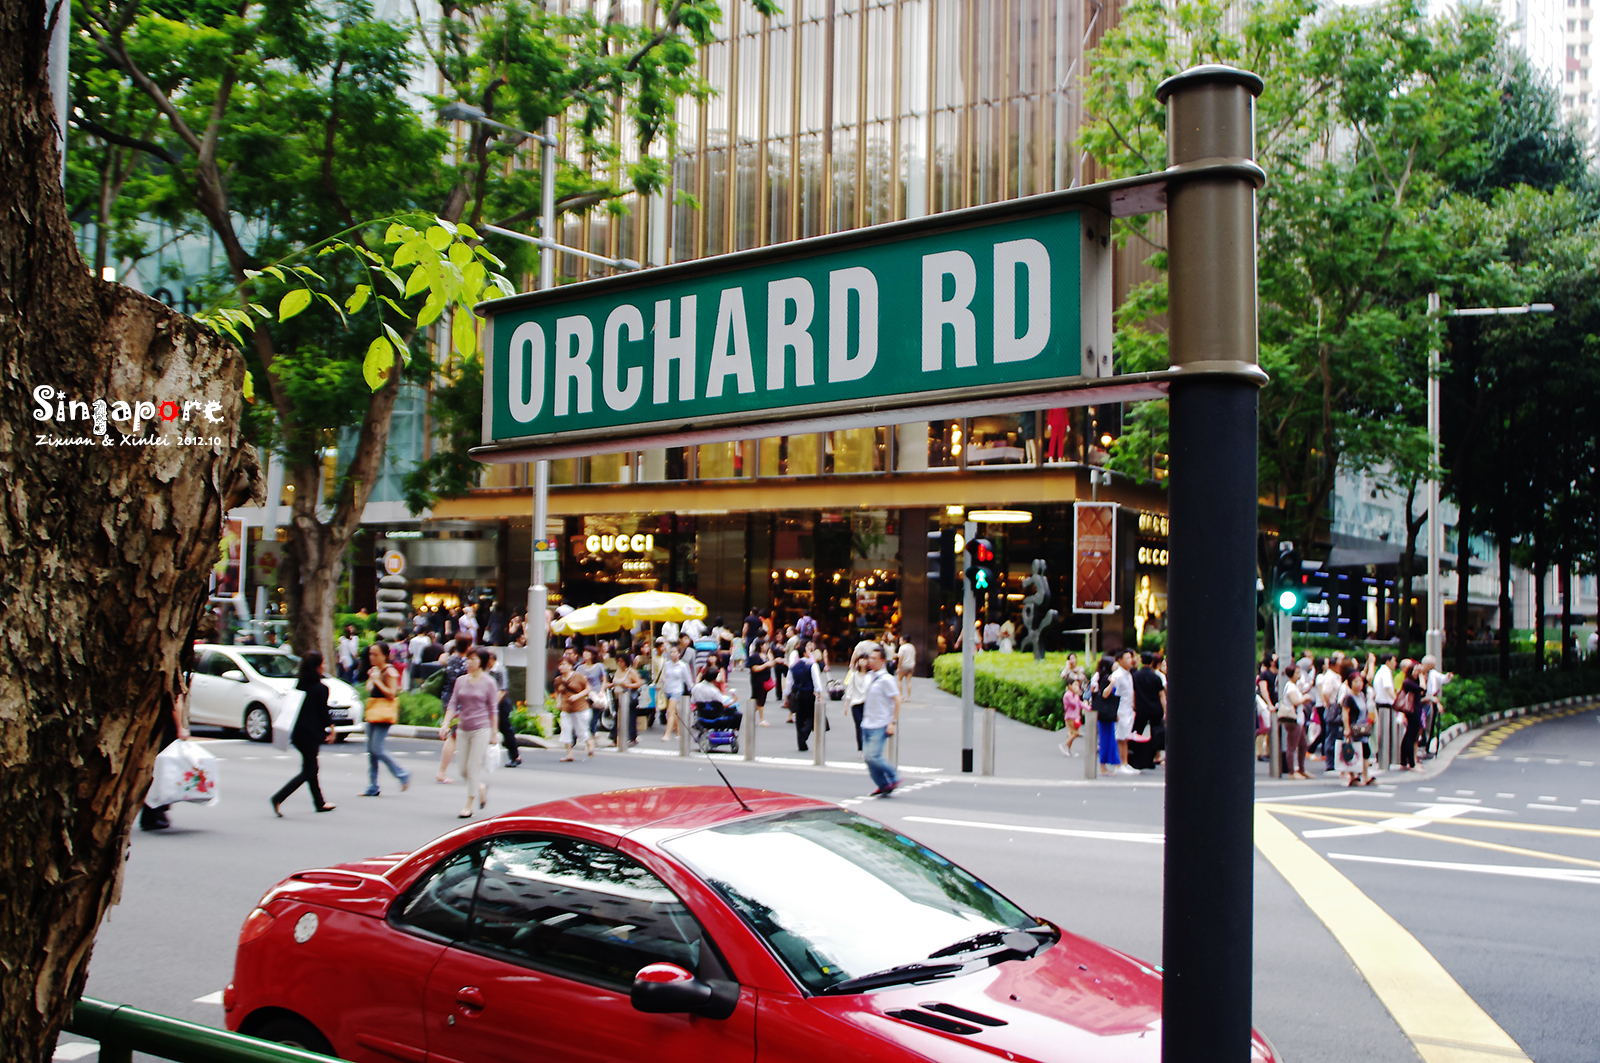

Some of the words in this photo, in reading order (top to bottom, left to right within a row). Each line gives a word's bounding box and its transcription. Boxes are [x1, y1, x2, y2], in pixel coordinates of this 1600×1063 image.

[508, 265, 880, 424] ORCHARD
[921, 238, 1052, 373] RD
[586, 534, 654, 553] GUCCI
